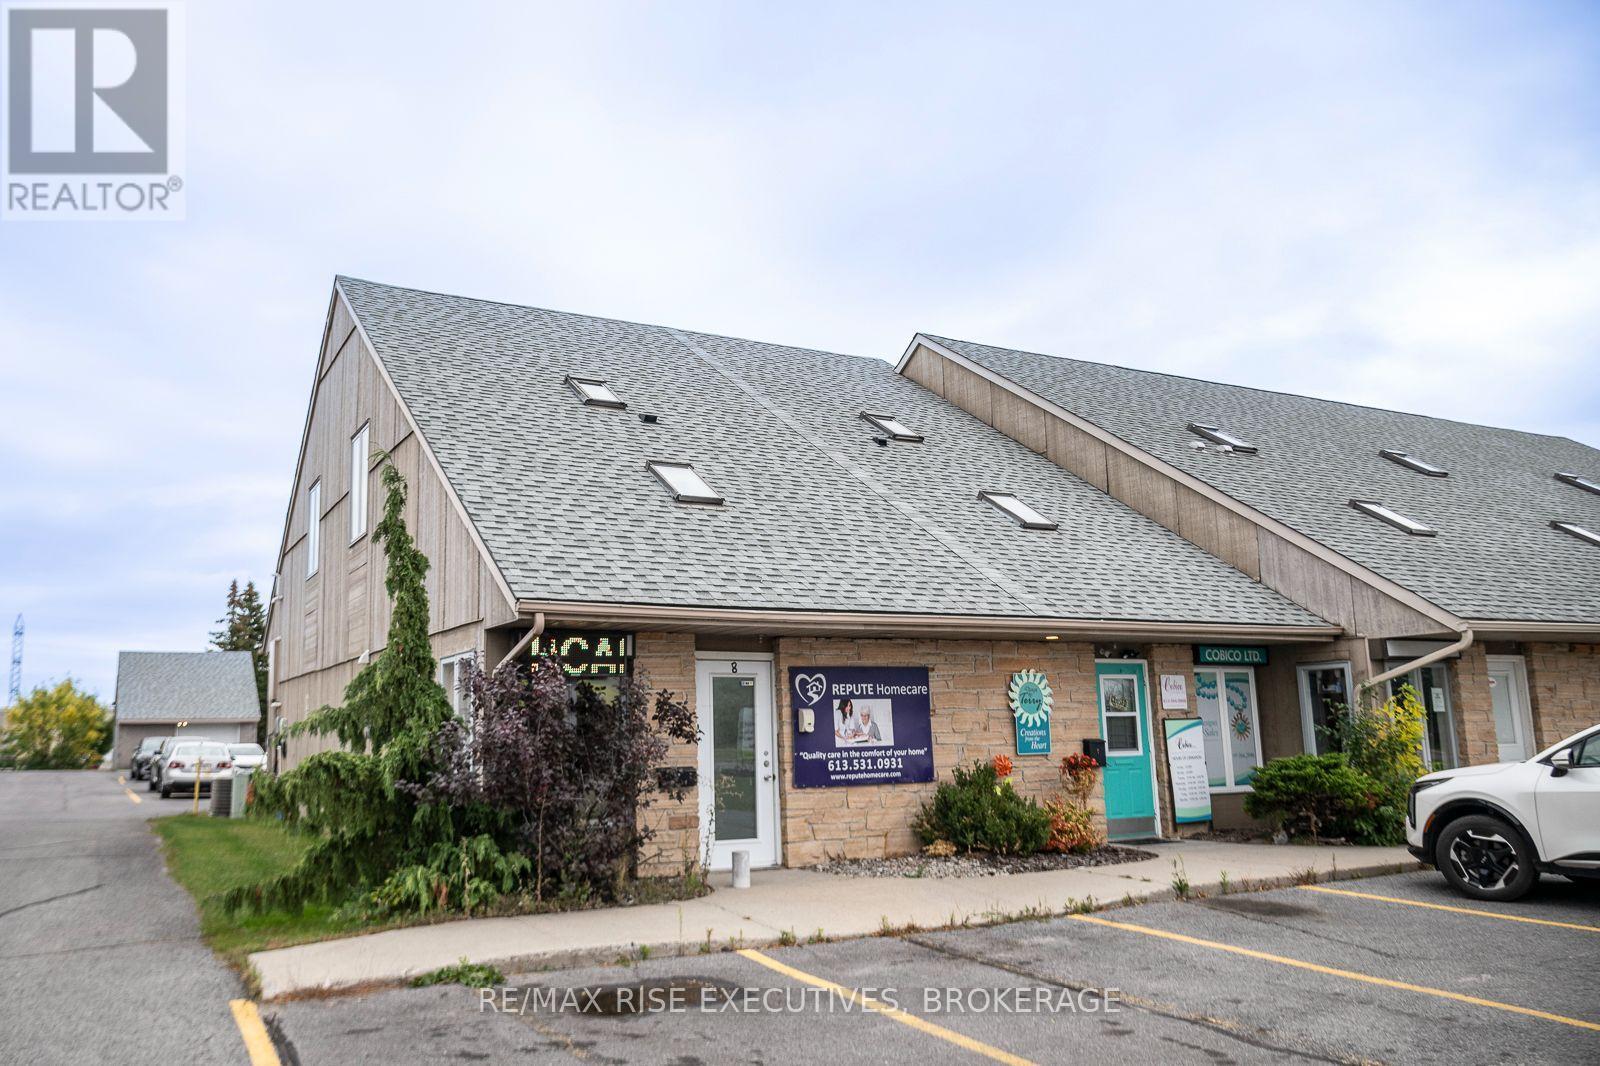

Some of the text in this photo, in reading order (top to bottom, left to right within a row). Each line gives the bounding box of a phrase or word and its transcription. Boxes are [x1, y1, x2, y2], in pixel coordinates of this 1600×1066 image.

[1205, 648, 1262, 662] COBICO LTD.
[731, 661, 738, 674] 8
[832, 683, 928, 696] REPUTE Homecare
[1020, 728, 1047, 737] Creations
[1031, 741, 1047, 751] Heart
[849, 750, 860, 758] the
[861, 749, 886, 758] comfort
[886, 748, 893, 757] of
[893, 750, 907, 758] your
[827, 758, 904, 771] 613.531.0931
[830, 771, 902, 780] www.reputehomecare.com
